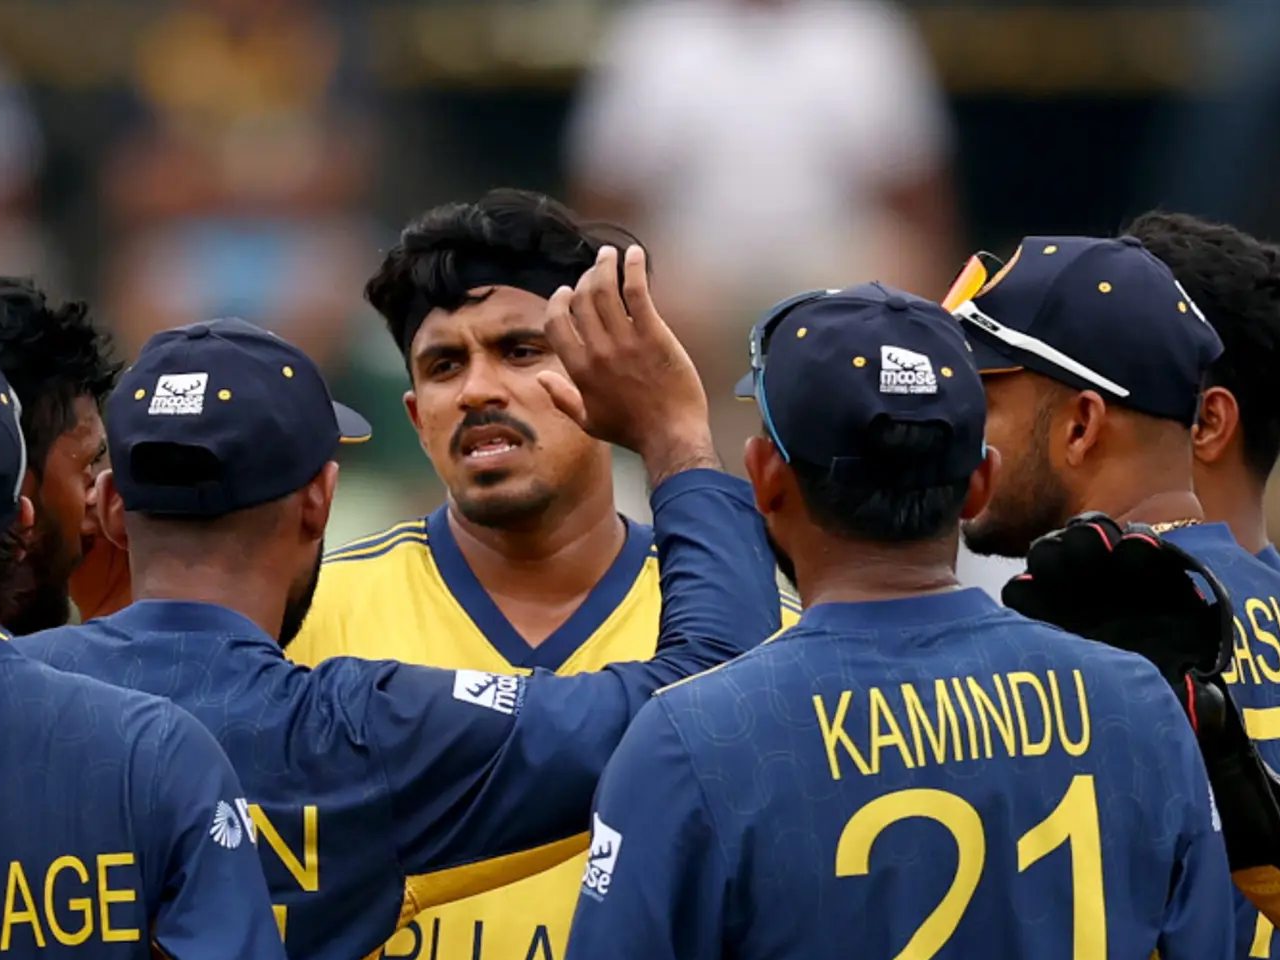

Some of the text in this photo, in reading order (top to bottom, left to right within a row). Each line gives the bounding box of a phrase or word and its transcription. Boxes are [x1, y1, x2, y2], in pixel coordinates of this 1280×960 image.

[881, 369, 937, 386] moose
[150, 394, 204, 410] moose
[812, 668, 1092, 780] KAMINDU
